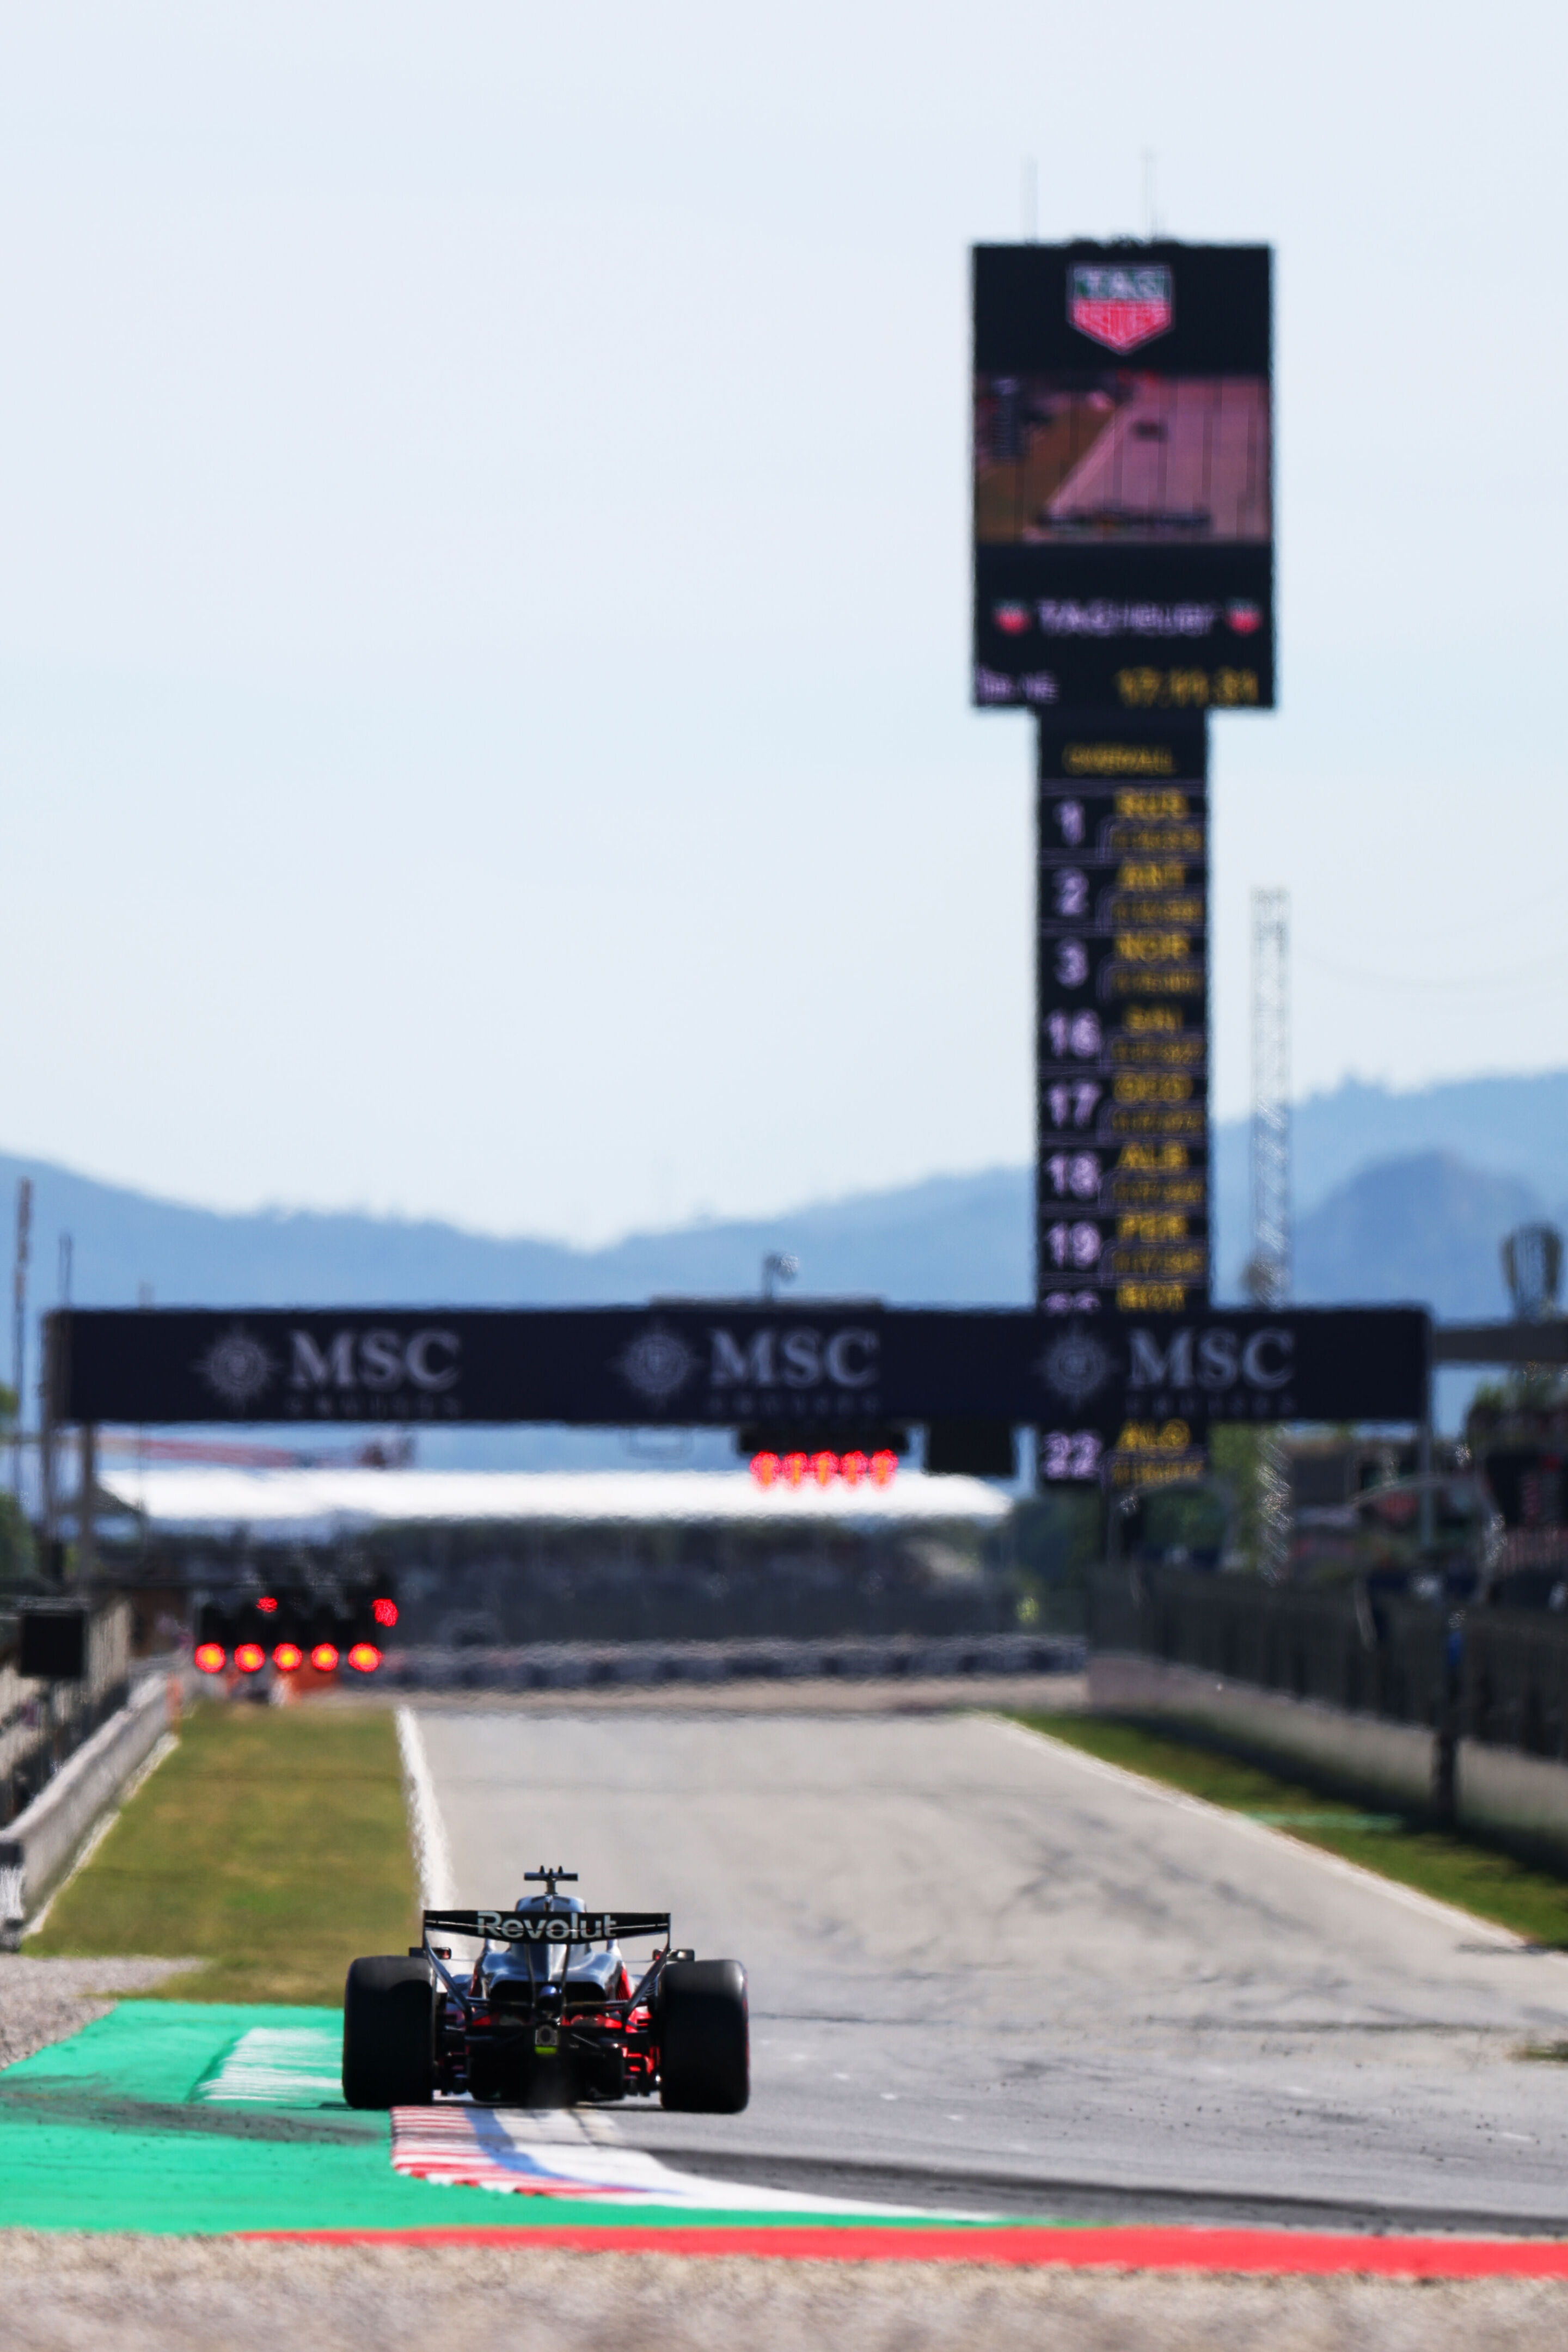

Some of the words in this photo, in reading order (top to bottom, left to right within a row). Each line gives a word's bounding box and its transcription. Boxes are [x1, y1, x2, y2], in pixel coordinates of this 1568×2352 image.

[1055, 799, 1085, 846] 1
[1054, 868, 1088, 916] 2
[1055, 937, 1088, 989] 3
[1047, 1009, 1101, 1057] 16
[1048, 1082, 1101, 1127] 17
[1046, 1151, 1101, 1196] 18
[1118, 1142, 1189, 1170] ALB
[1046, 1222, 1101, 1267] 19
[290, 1328, 458, 1390] MSC
[710, 1327, 878, 1388] MSC
[1129, 1327, 1295, 1389] MSC
[1044, 1431, 1102, 1479] 22
[1118, 1419, 1191, 1450] ALO
[476, 1911, 617, 1939] Revolut
